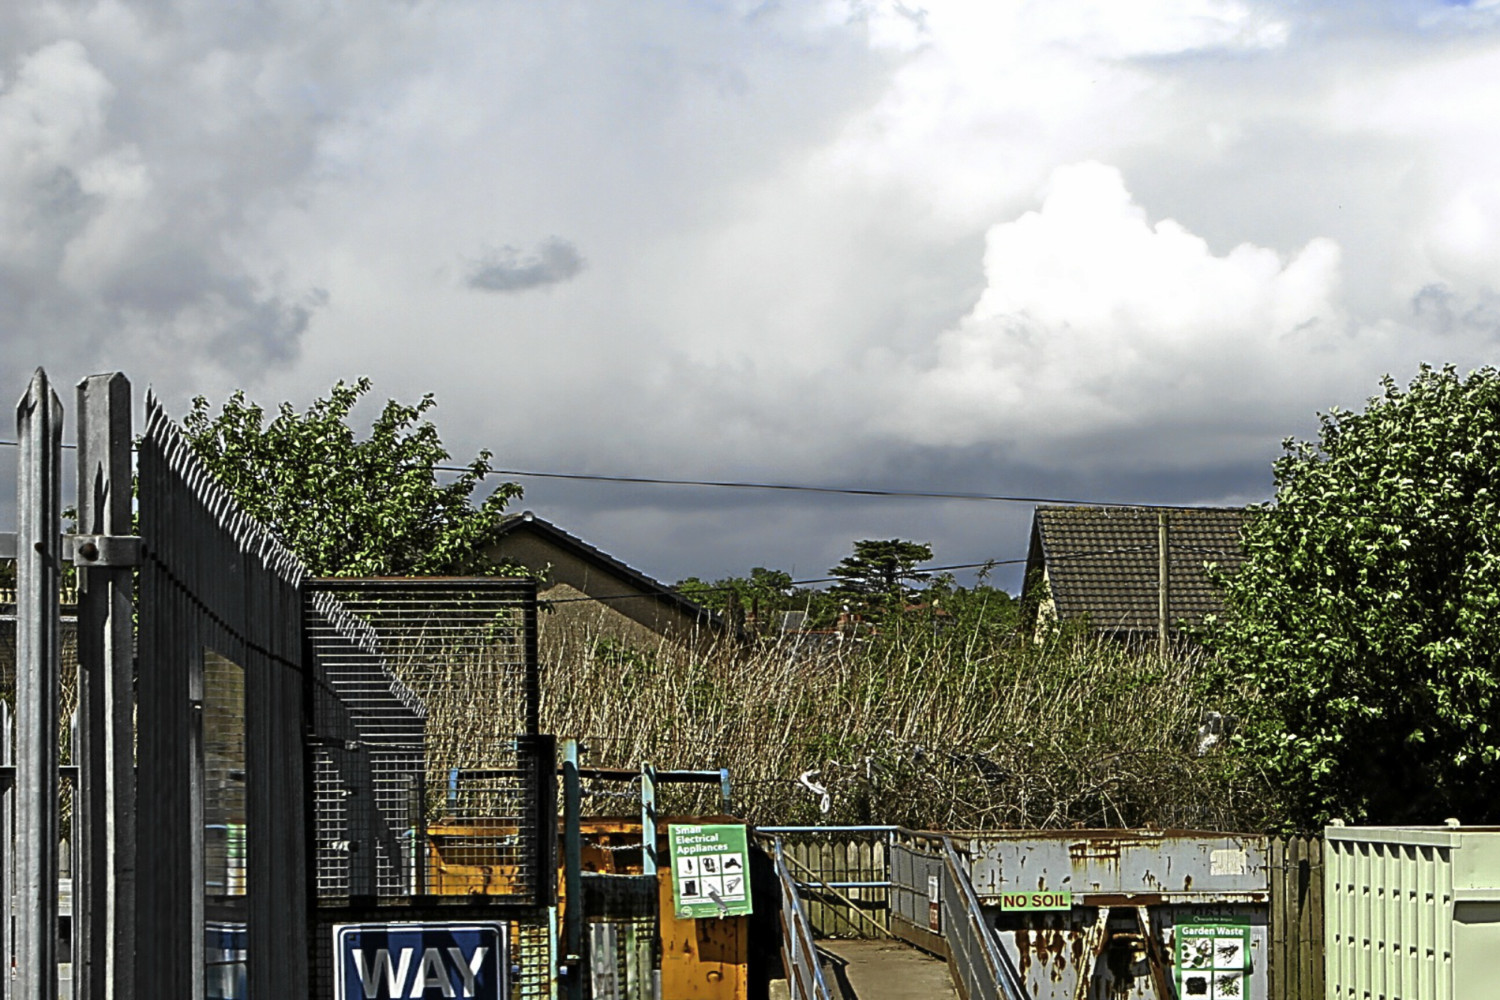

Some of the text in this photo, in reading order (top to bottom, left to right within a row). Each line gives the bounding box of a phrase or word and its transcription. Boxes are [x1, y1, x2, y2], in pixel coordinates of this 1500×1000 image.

[675, 833, 719, 844] Electrical
[676, 844, 728, 855] Appliances
[1003, 894, 1068, 908] NO SOIL
[1181, 927, 1215, 936] Garden
[1216, 927, 1244, 936] Waste
[352, 947, 489, 999] WAY
